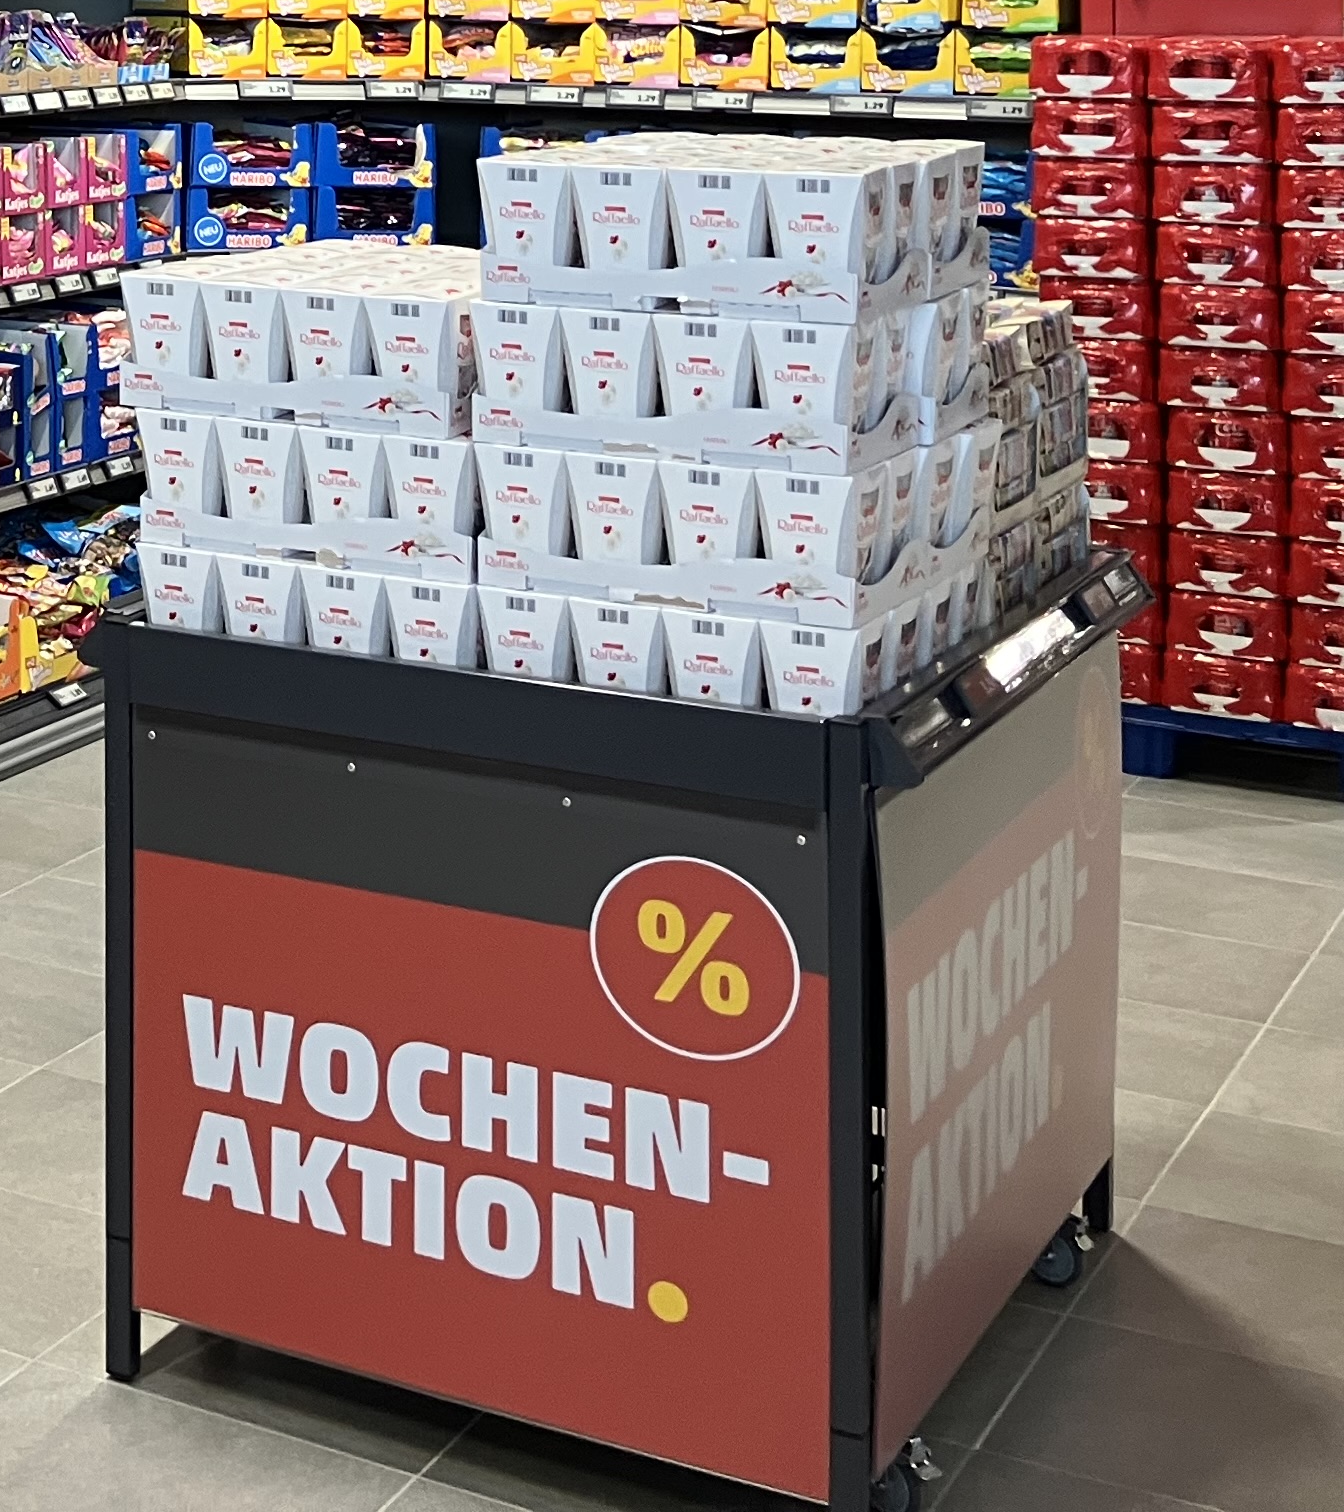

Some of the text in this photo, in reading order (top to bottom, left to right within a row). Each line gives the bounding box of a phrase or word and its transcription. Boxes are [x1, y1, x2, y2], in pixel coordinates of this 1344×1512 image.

[202, 163, 223, 175] NEU
[232, 174, 274, 186] HARIBO
[499, 206, 546, 222] Raffaello
[140, 317, 181, 333] Raffaello
[318, 474, 361, 490] Raffaello
[683, 660, 733, 676] Raffaello
[638, 899, 750, 1016] %
[906, 829, 1089, 1122] WOCHEN-
[182, 993, 769, 1204] WOCHEN-
[182, 1111, 689, 1324] AKTION.
